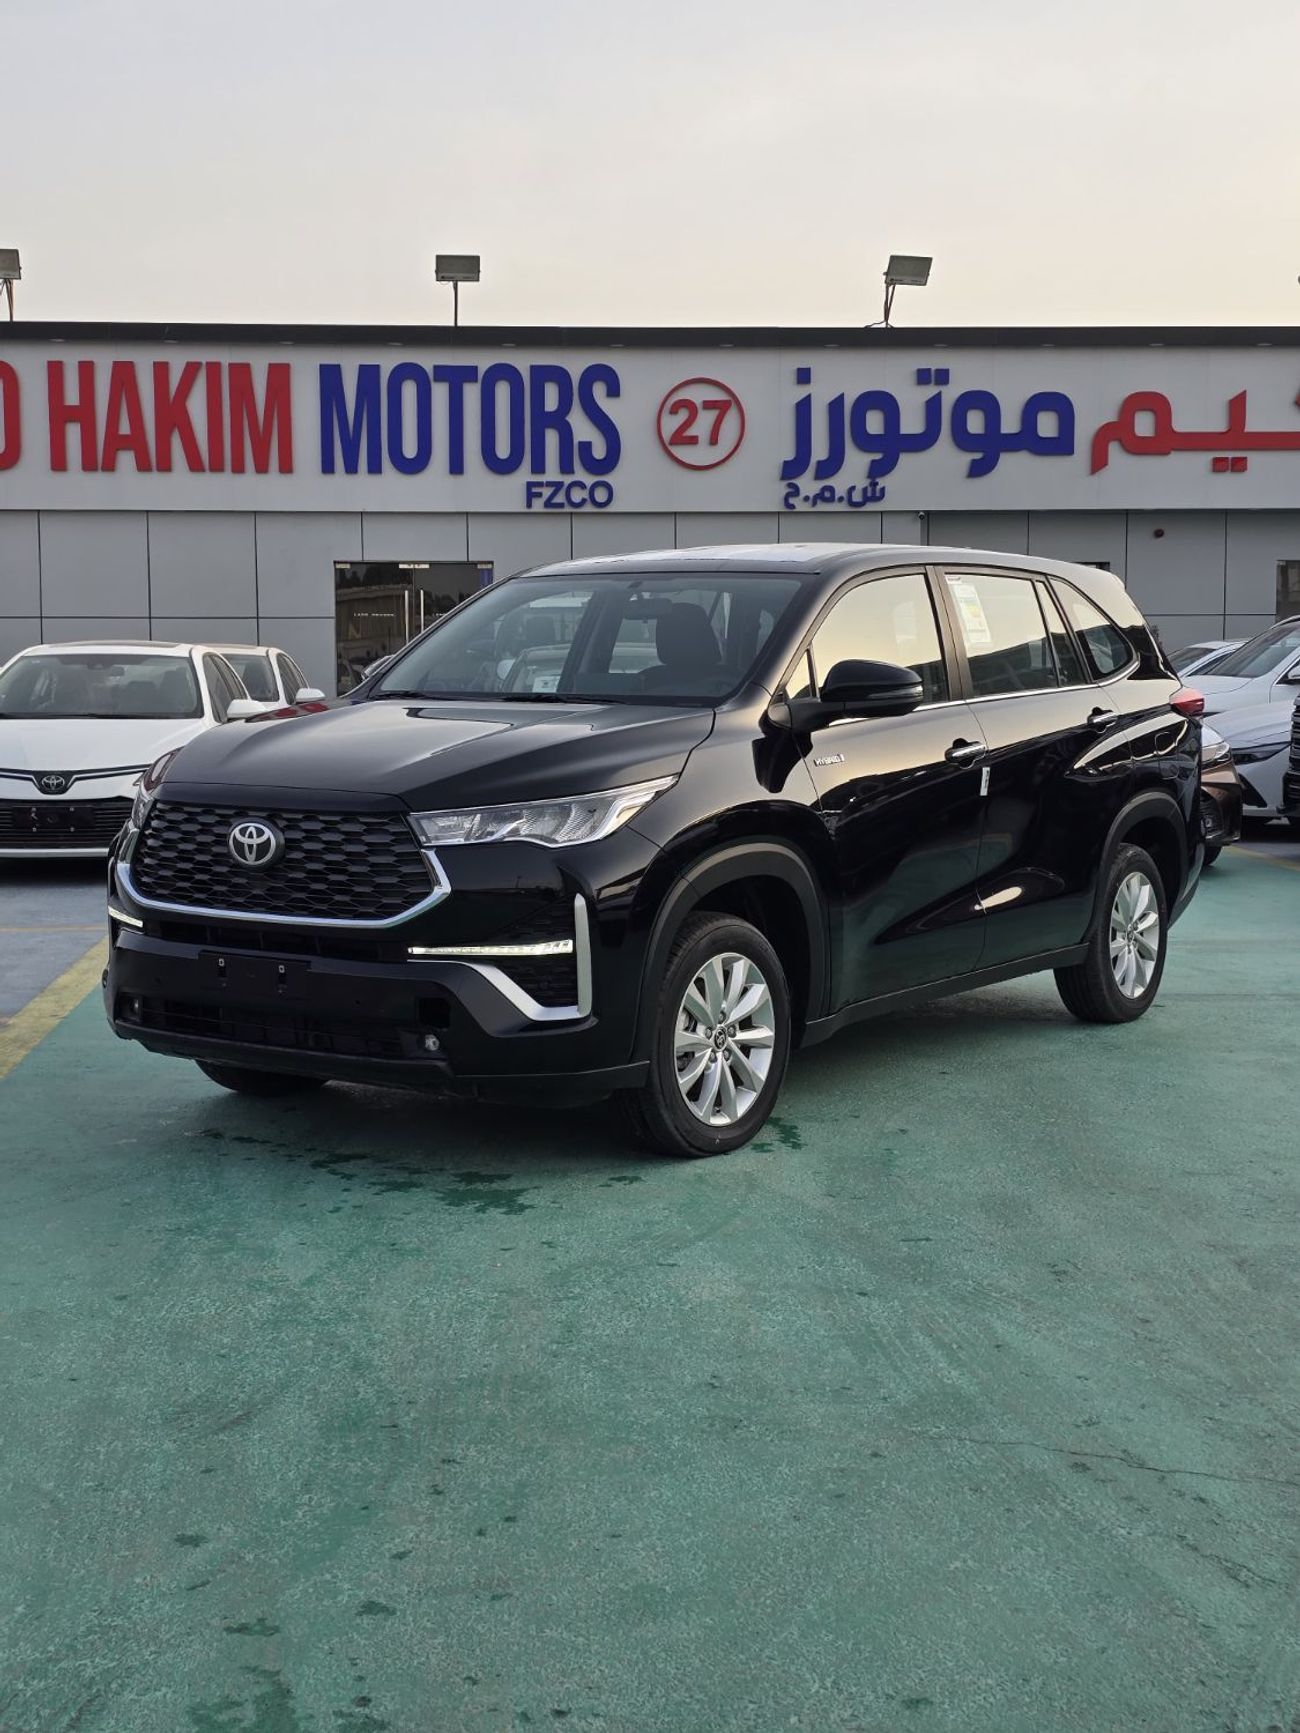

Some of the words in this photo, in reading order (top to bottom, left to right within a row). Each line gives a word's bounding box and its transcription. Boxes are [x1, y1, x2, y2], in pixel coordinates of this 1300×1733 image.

[47, 360, 294, 474] HAKIM
[318, 361, 623, 476] MOTORS
[667, 398, 734, 446] 27
[780, 367, 1076, 480] موتورز
[525, 480, 614, 510] FZCO
